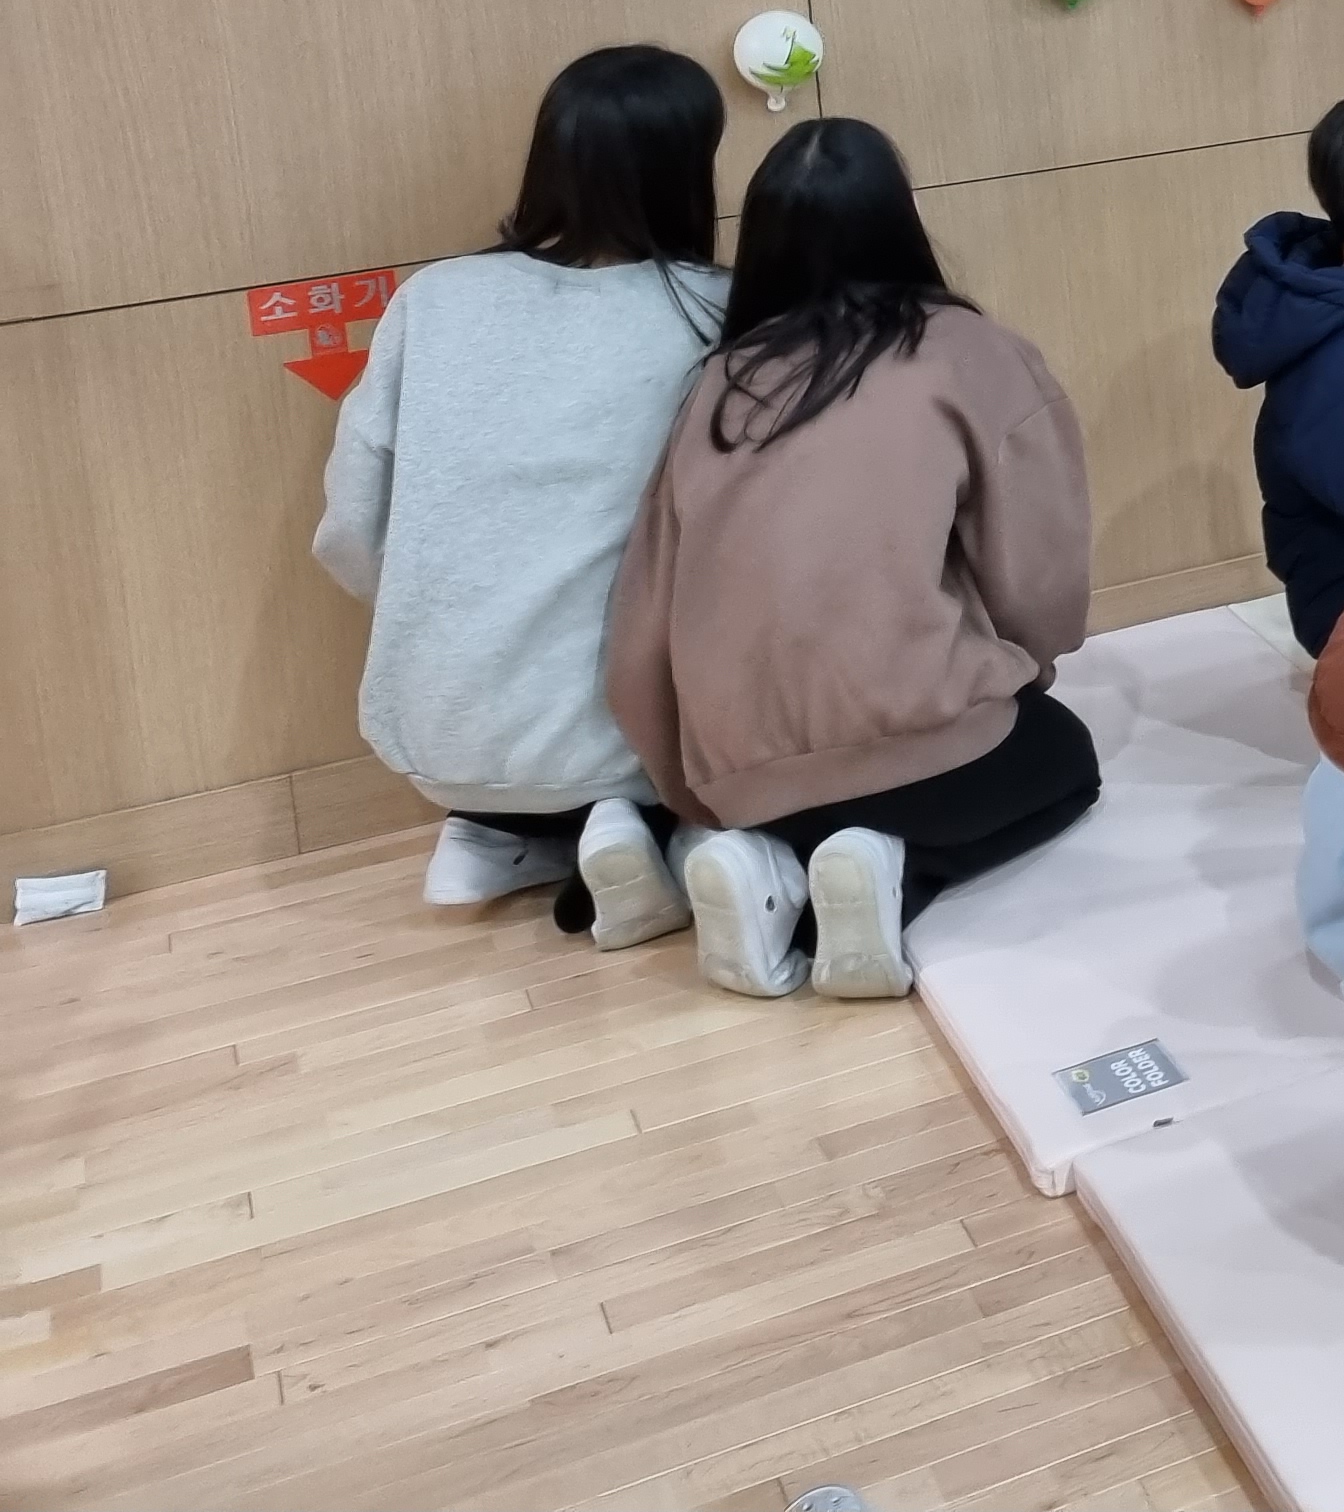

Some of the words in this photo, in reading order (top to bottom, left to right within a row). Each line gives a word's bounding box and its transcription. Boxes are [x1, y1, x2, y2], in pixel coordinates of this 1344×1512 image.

[259, 275, 389, 322] 소화기
[1110, 1059, 1147, 1094] COLOR
[1128, 1047, 1170, 1088] FOLDER
